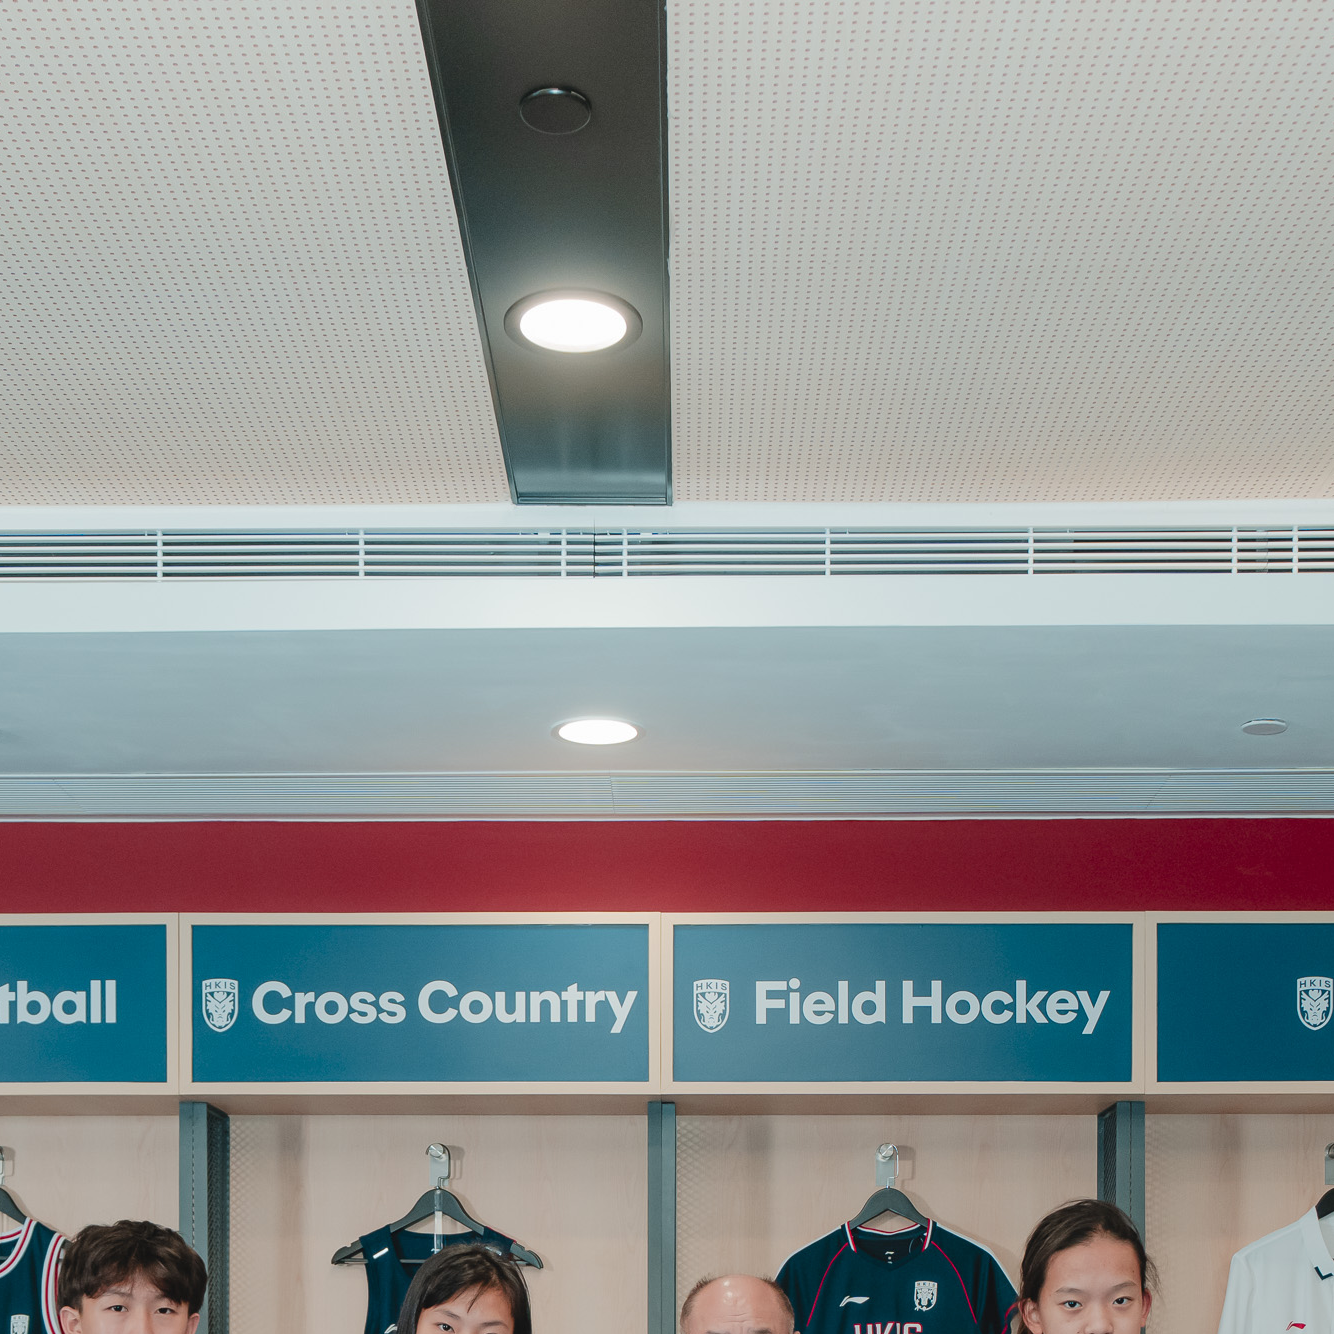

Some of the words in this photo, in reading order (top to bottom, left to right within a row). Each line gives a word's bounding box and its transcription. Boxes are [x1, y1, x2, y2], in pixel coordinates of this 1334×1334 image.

[205, 981, 236, 990] HKIS
[696, 982, 727, 991] HKIS
[1299, 980, 1331, 989] HKIS
[251, 980, 407, 1025] Cross
[417, 979, 638, 1034] Country
[755, 977, 886, 1025] Field
[902, 979, 1111, 1035] Hockey
